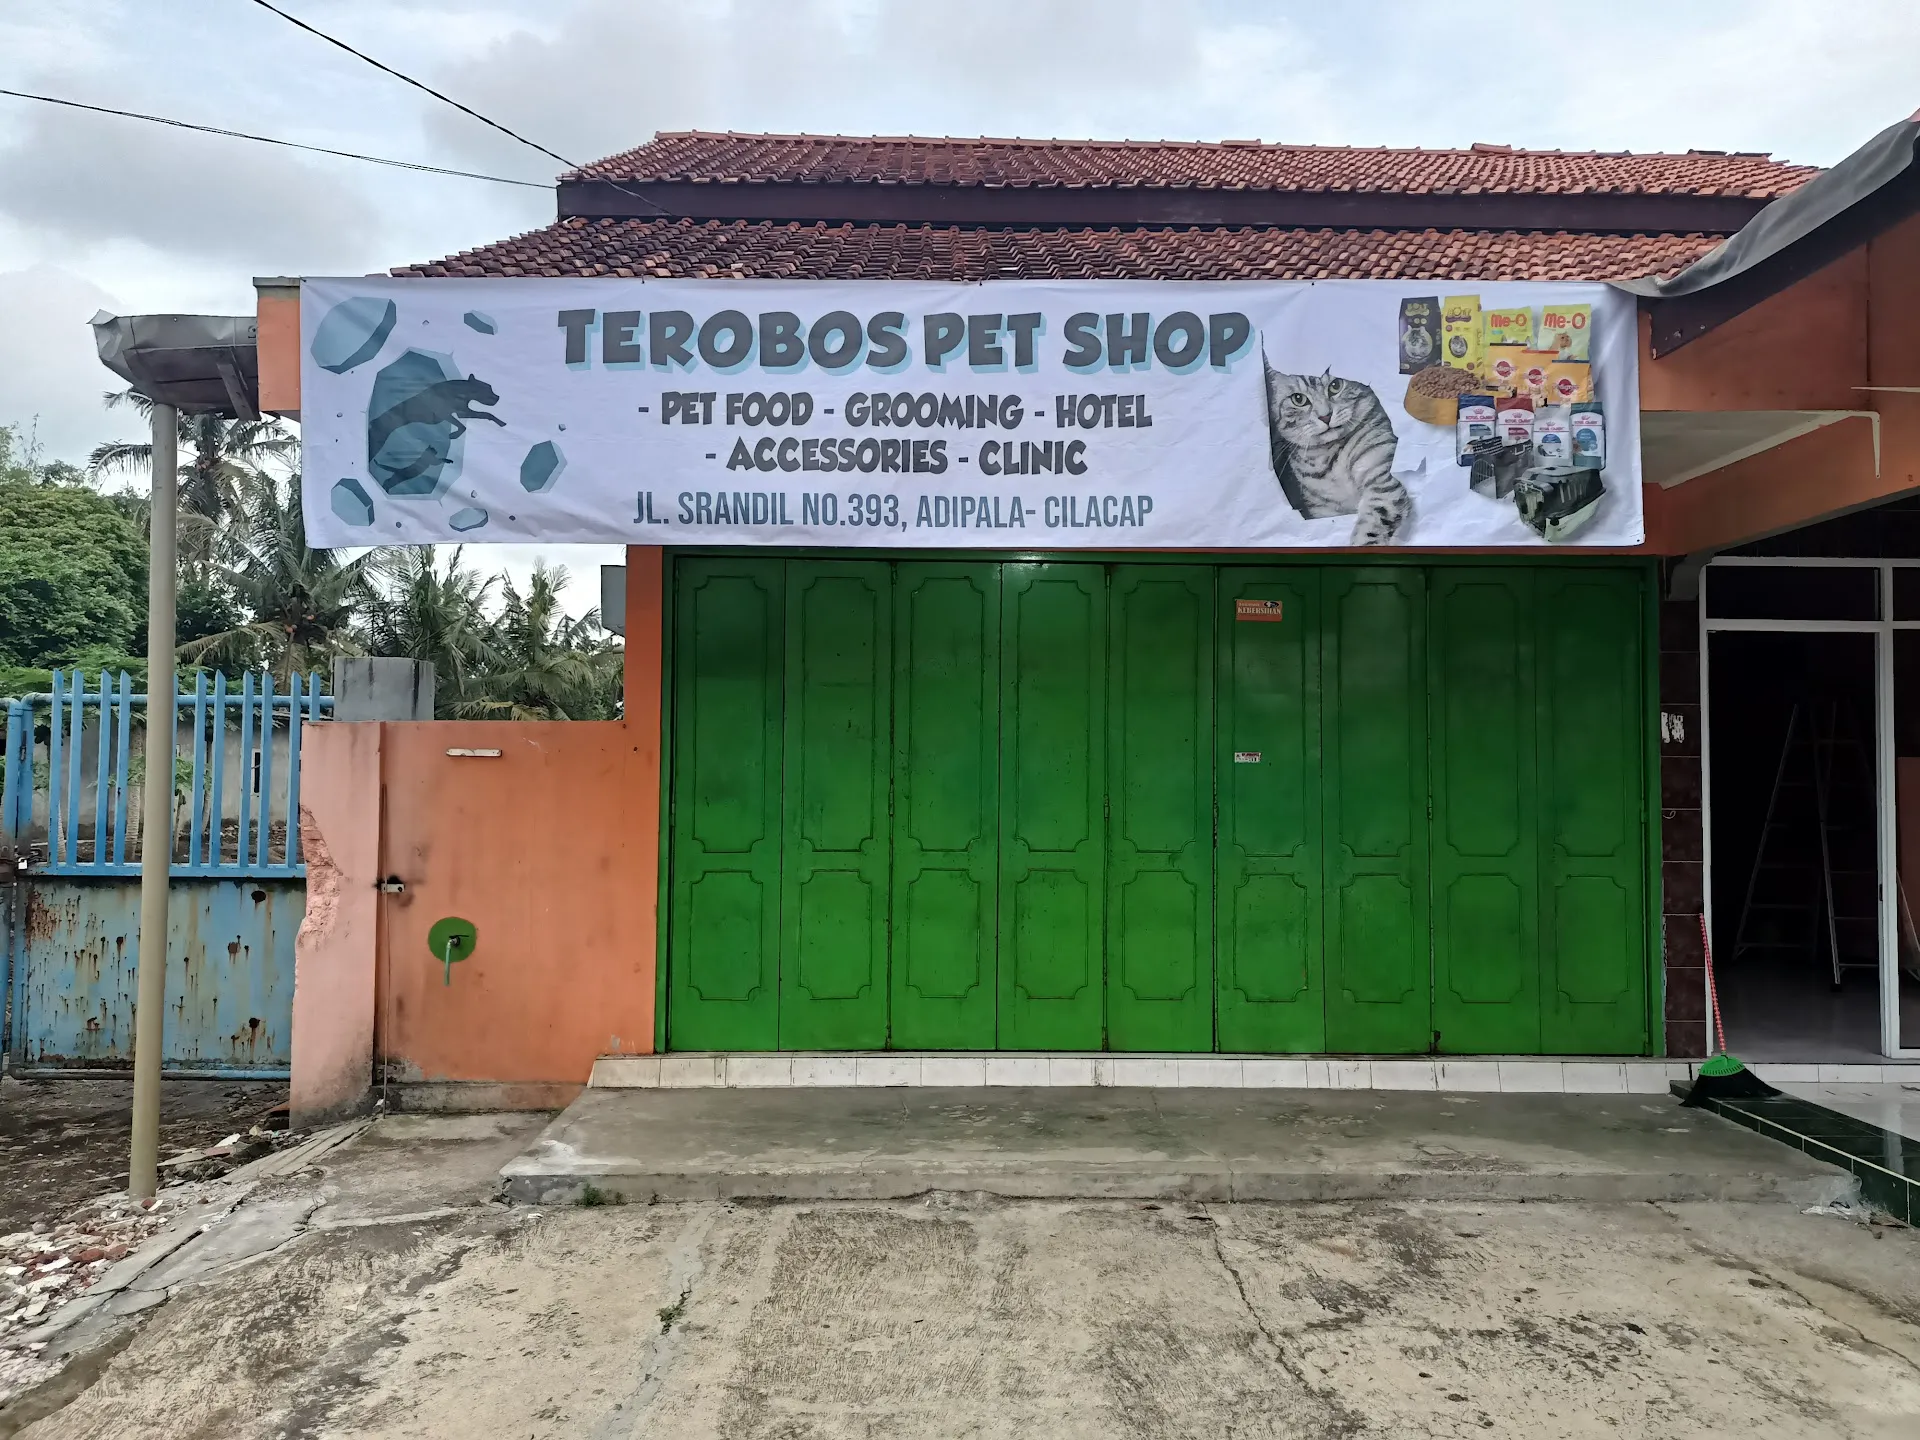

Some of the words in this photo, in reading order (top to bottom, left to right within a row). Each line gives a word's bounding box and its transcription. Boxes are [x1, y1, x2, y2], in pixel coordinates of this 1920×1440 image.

[1490, 313, 1527, 328] Me-O
[1543, 312, 1586, 329] Me-O
[558, 309, 912, 375] TEROBOS
[923, 312, 1046, 374] PET
[1062, 311, 1255, 375] SHOP
[661, 391, 717, 425] PET
[726, 391, 814, 427] FOOD
[845, 392, 1024, 430] GROOMING
[1056, 393, 1153, 430] HOTEL
[726, 436, 948, 475] ACCESSORIES
[979, 440, 1088, 476] CLINIC
[633, 491, 669, 525] JL.
[678, 491, 794, 525] SRANDIL
[802, 492, 908, 532] NO.393,
[1044, 495, 1154, 528] CILACAP
